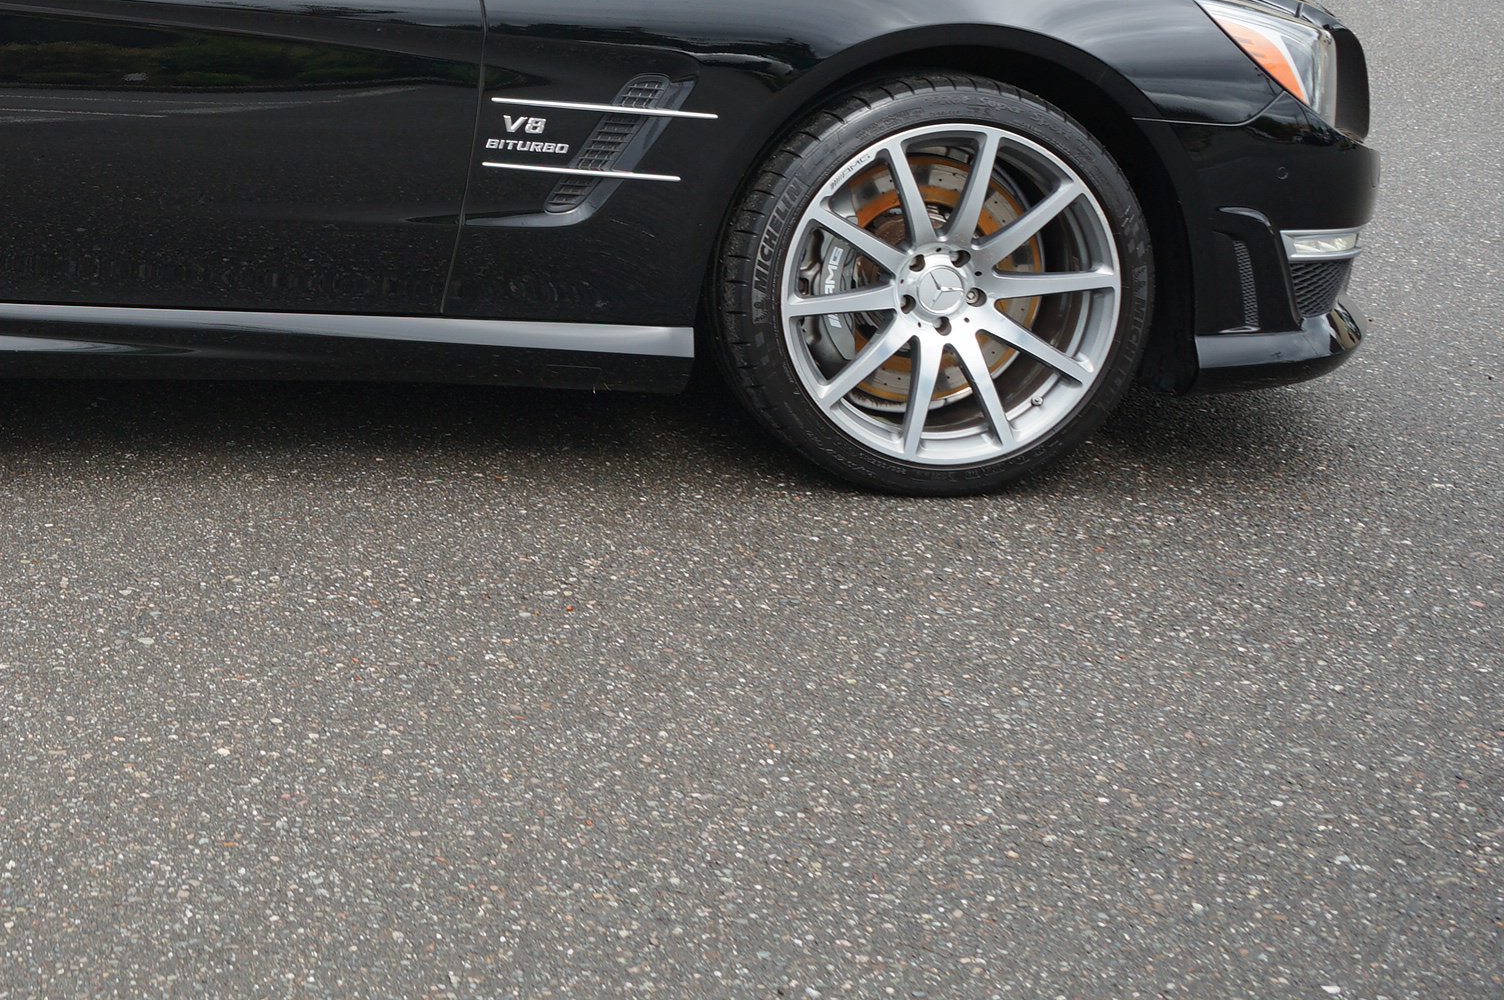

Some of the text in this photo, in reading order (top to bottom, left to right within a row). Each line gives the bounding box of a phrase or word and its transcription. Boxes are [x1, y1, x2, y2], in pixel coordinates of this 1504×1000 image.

[503, 115, 546, 133] V8
[485, 138, 569, 154] BITURBO
[753, 181, 802, 294] MICHELIN
